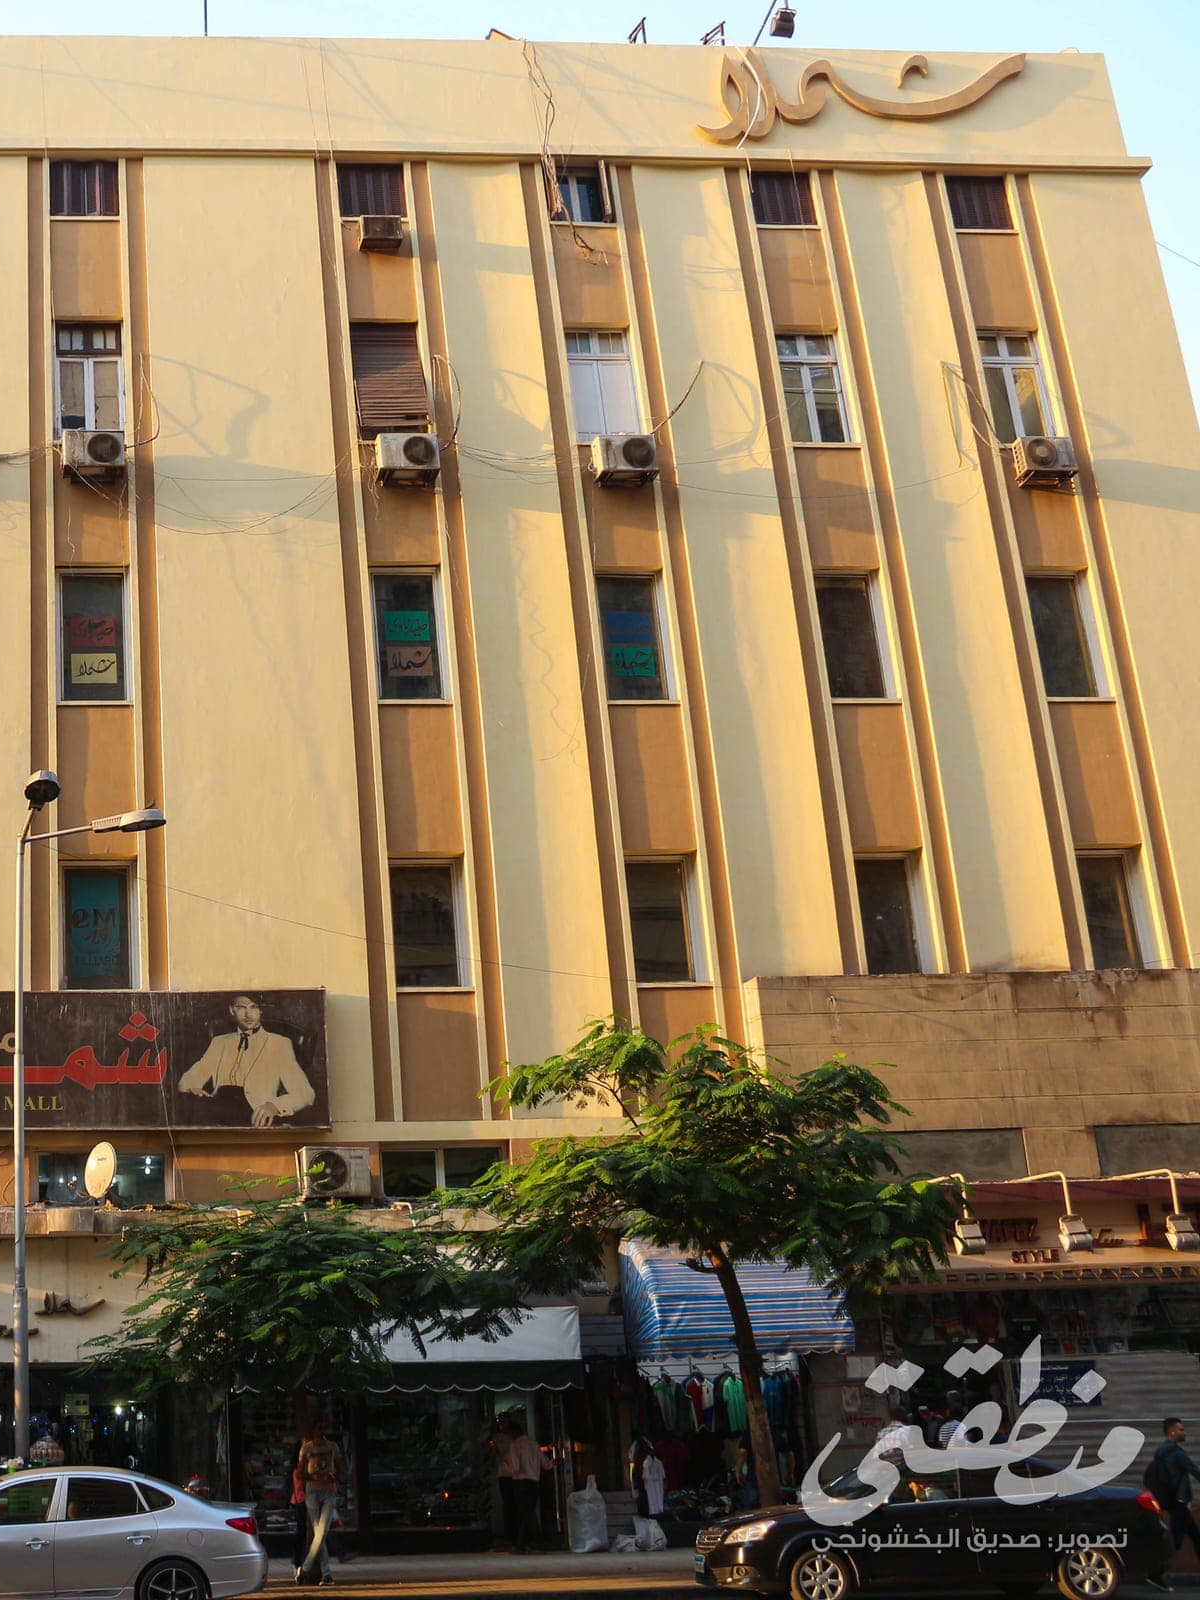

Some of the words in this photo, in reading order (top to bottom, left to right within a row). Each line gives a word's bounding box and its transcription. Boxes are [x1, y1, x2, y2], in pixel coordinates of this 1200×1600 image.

[696, 48, 1027, 144] شملا
[389, 649, 432, 671] شملا
[72, 907, 117, 929] 2M
[1010, 1249, 1060, 1265] STYLE
